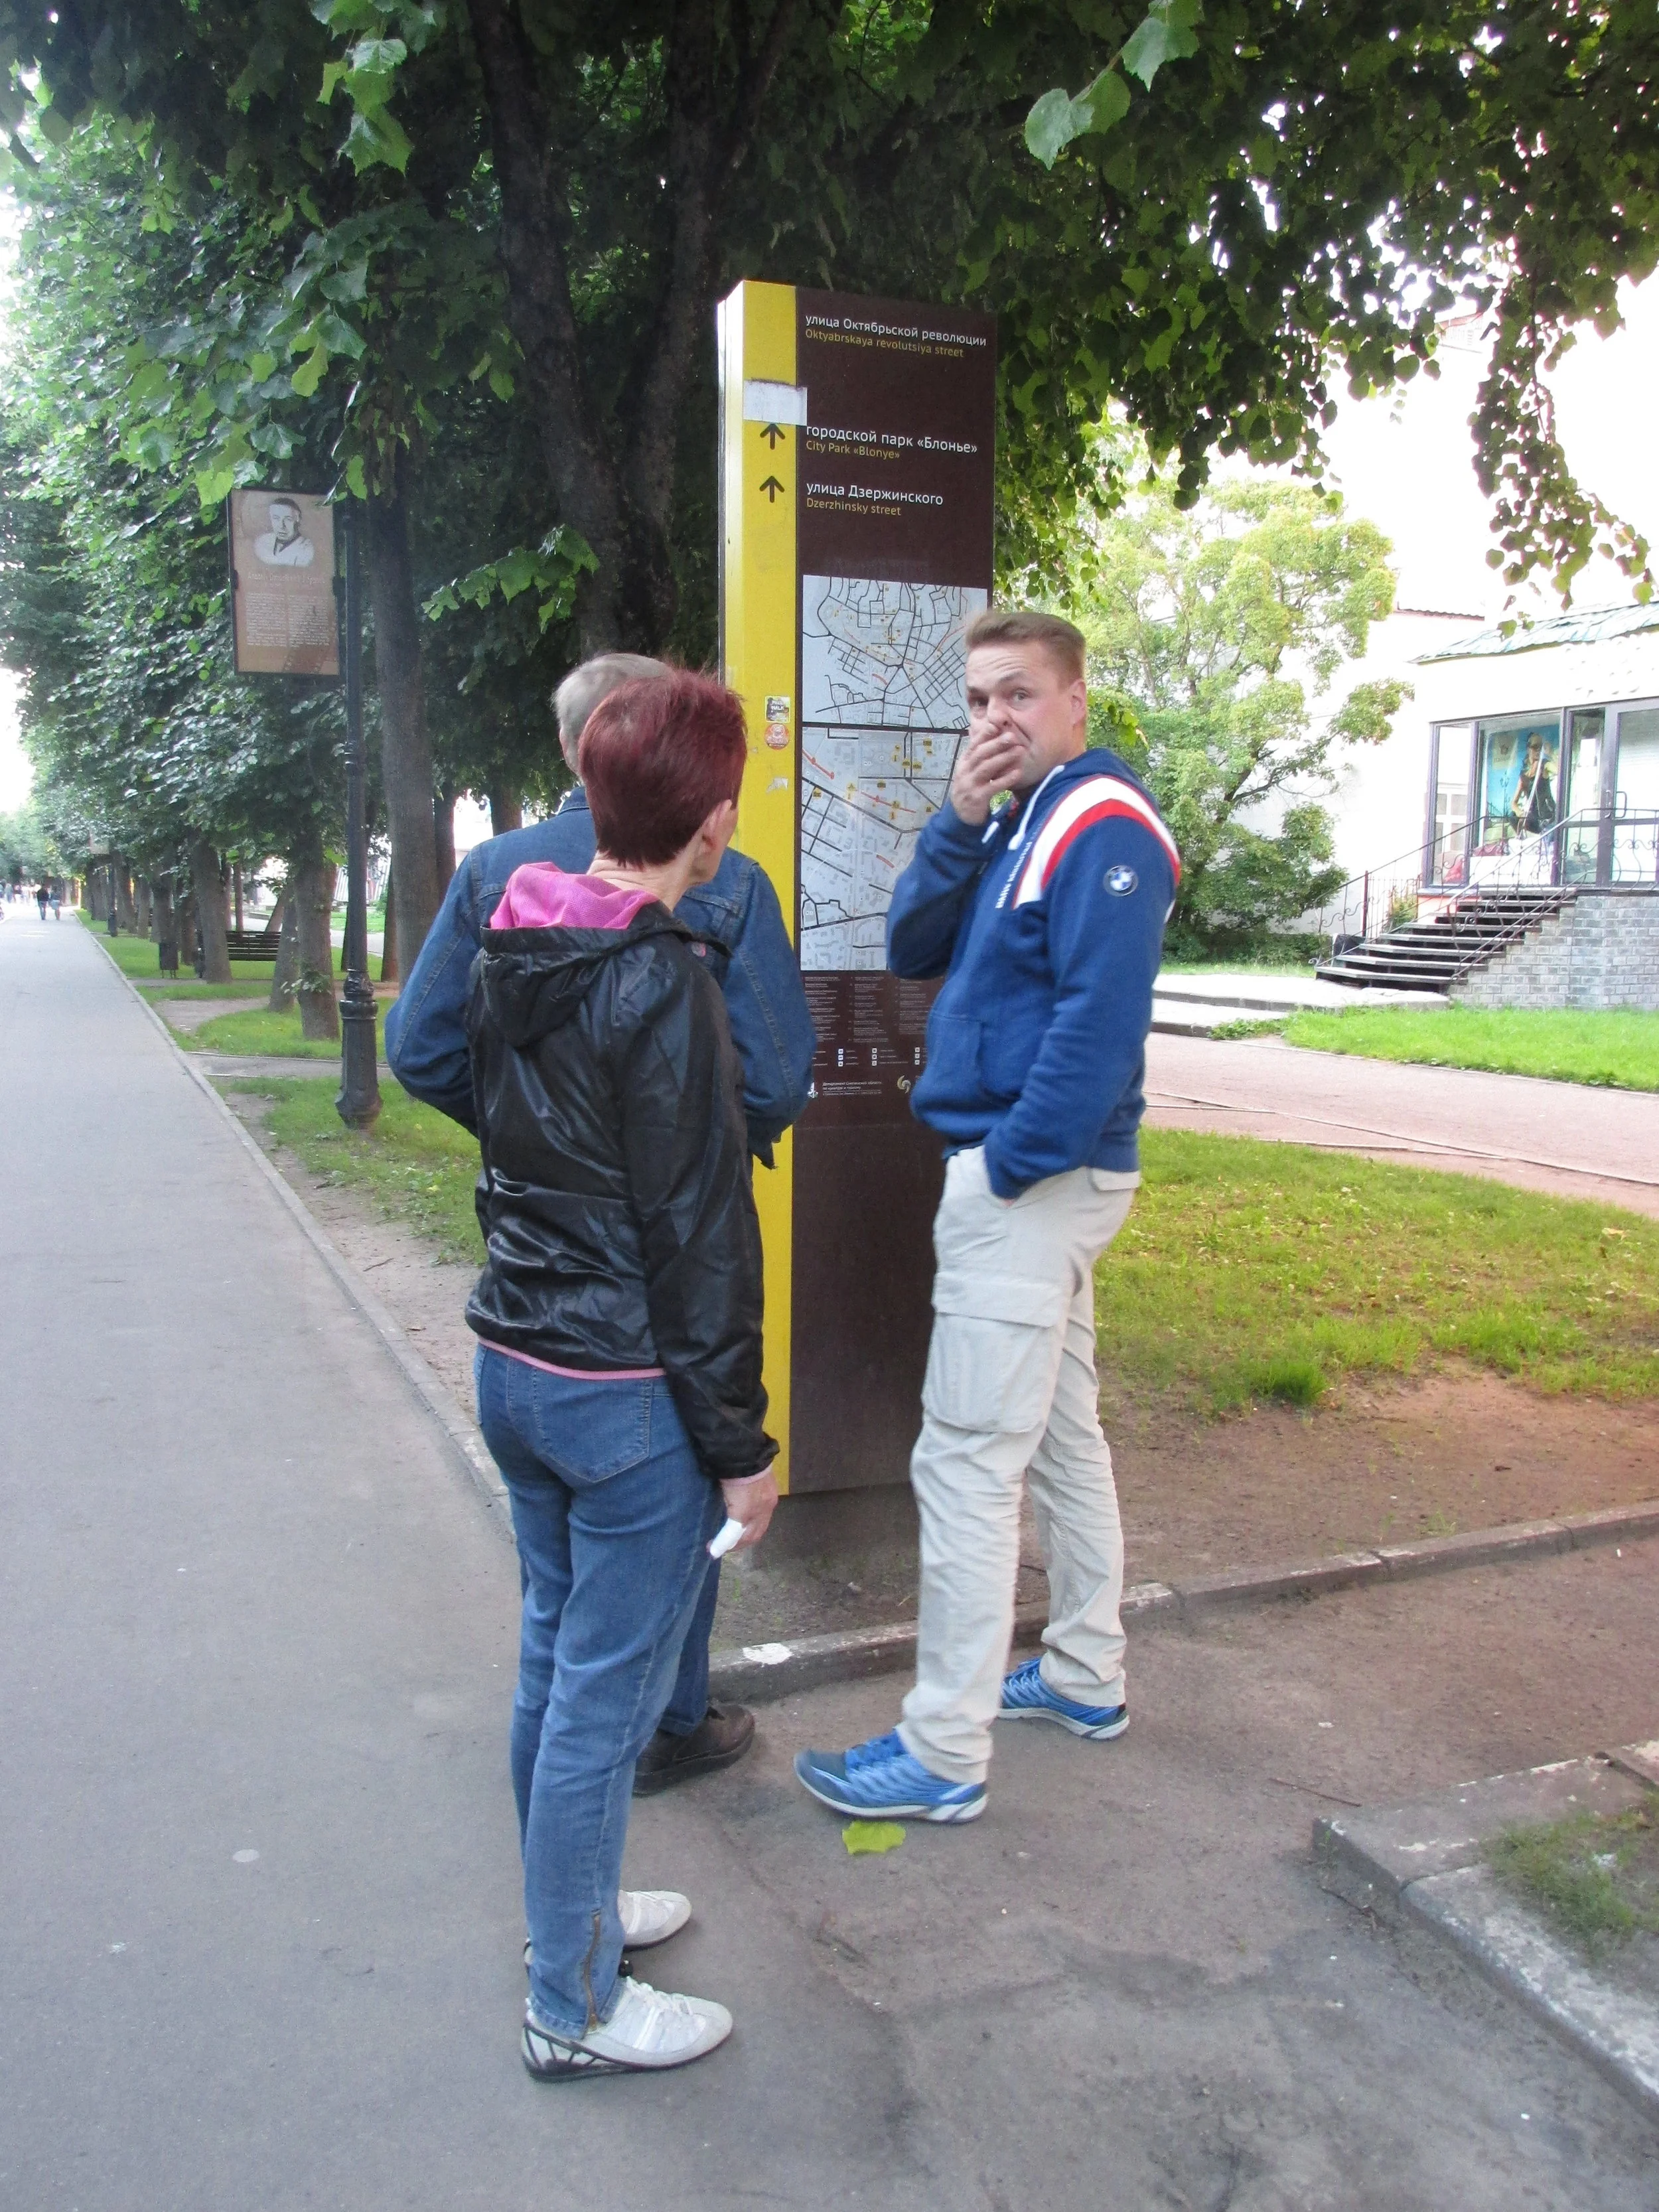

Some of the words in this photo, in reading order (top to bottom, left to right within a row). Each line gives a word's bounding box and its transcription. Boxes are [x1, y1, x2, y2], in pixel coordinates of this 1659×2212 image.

[805, 315, 839, 329] улица
[843, 318, 918, 338] Октябрьской
[922, 331, 987, 346] революции
[805, 329, 873, 347] Oktyabrskaya
[876, 339, 932, 354] revolutsiya
[934, 345, 964, 358] street
[806, 425, 877, 443] городской
[881, 434, 914, 449] парк
[917, 436, 977, 453] «Блонье»
[806, 440, 826, 453] City
[828, 443, 850, 454] Park
[853, 445, 901, 460] «Blonye»
[806, 482, 845, 497] улица
[848, 484, 944, 506] Дзержинского
[806, 497, 869, 515] Dzerzhinsky
[871, 504, 901, 516] street
